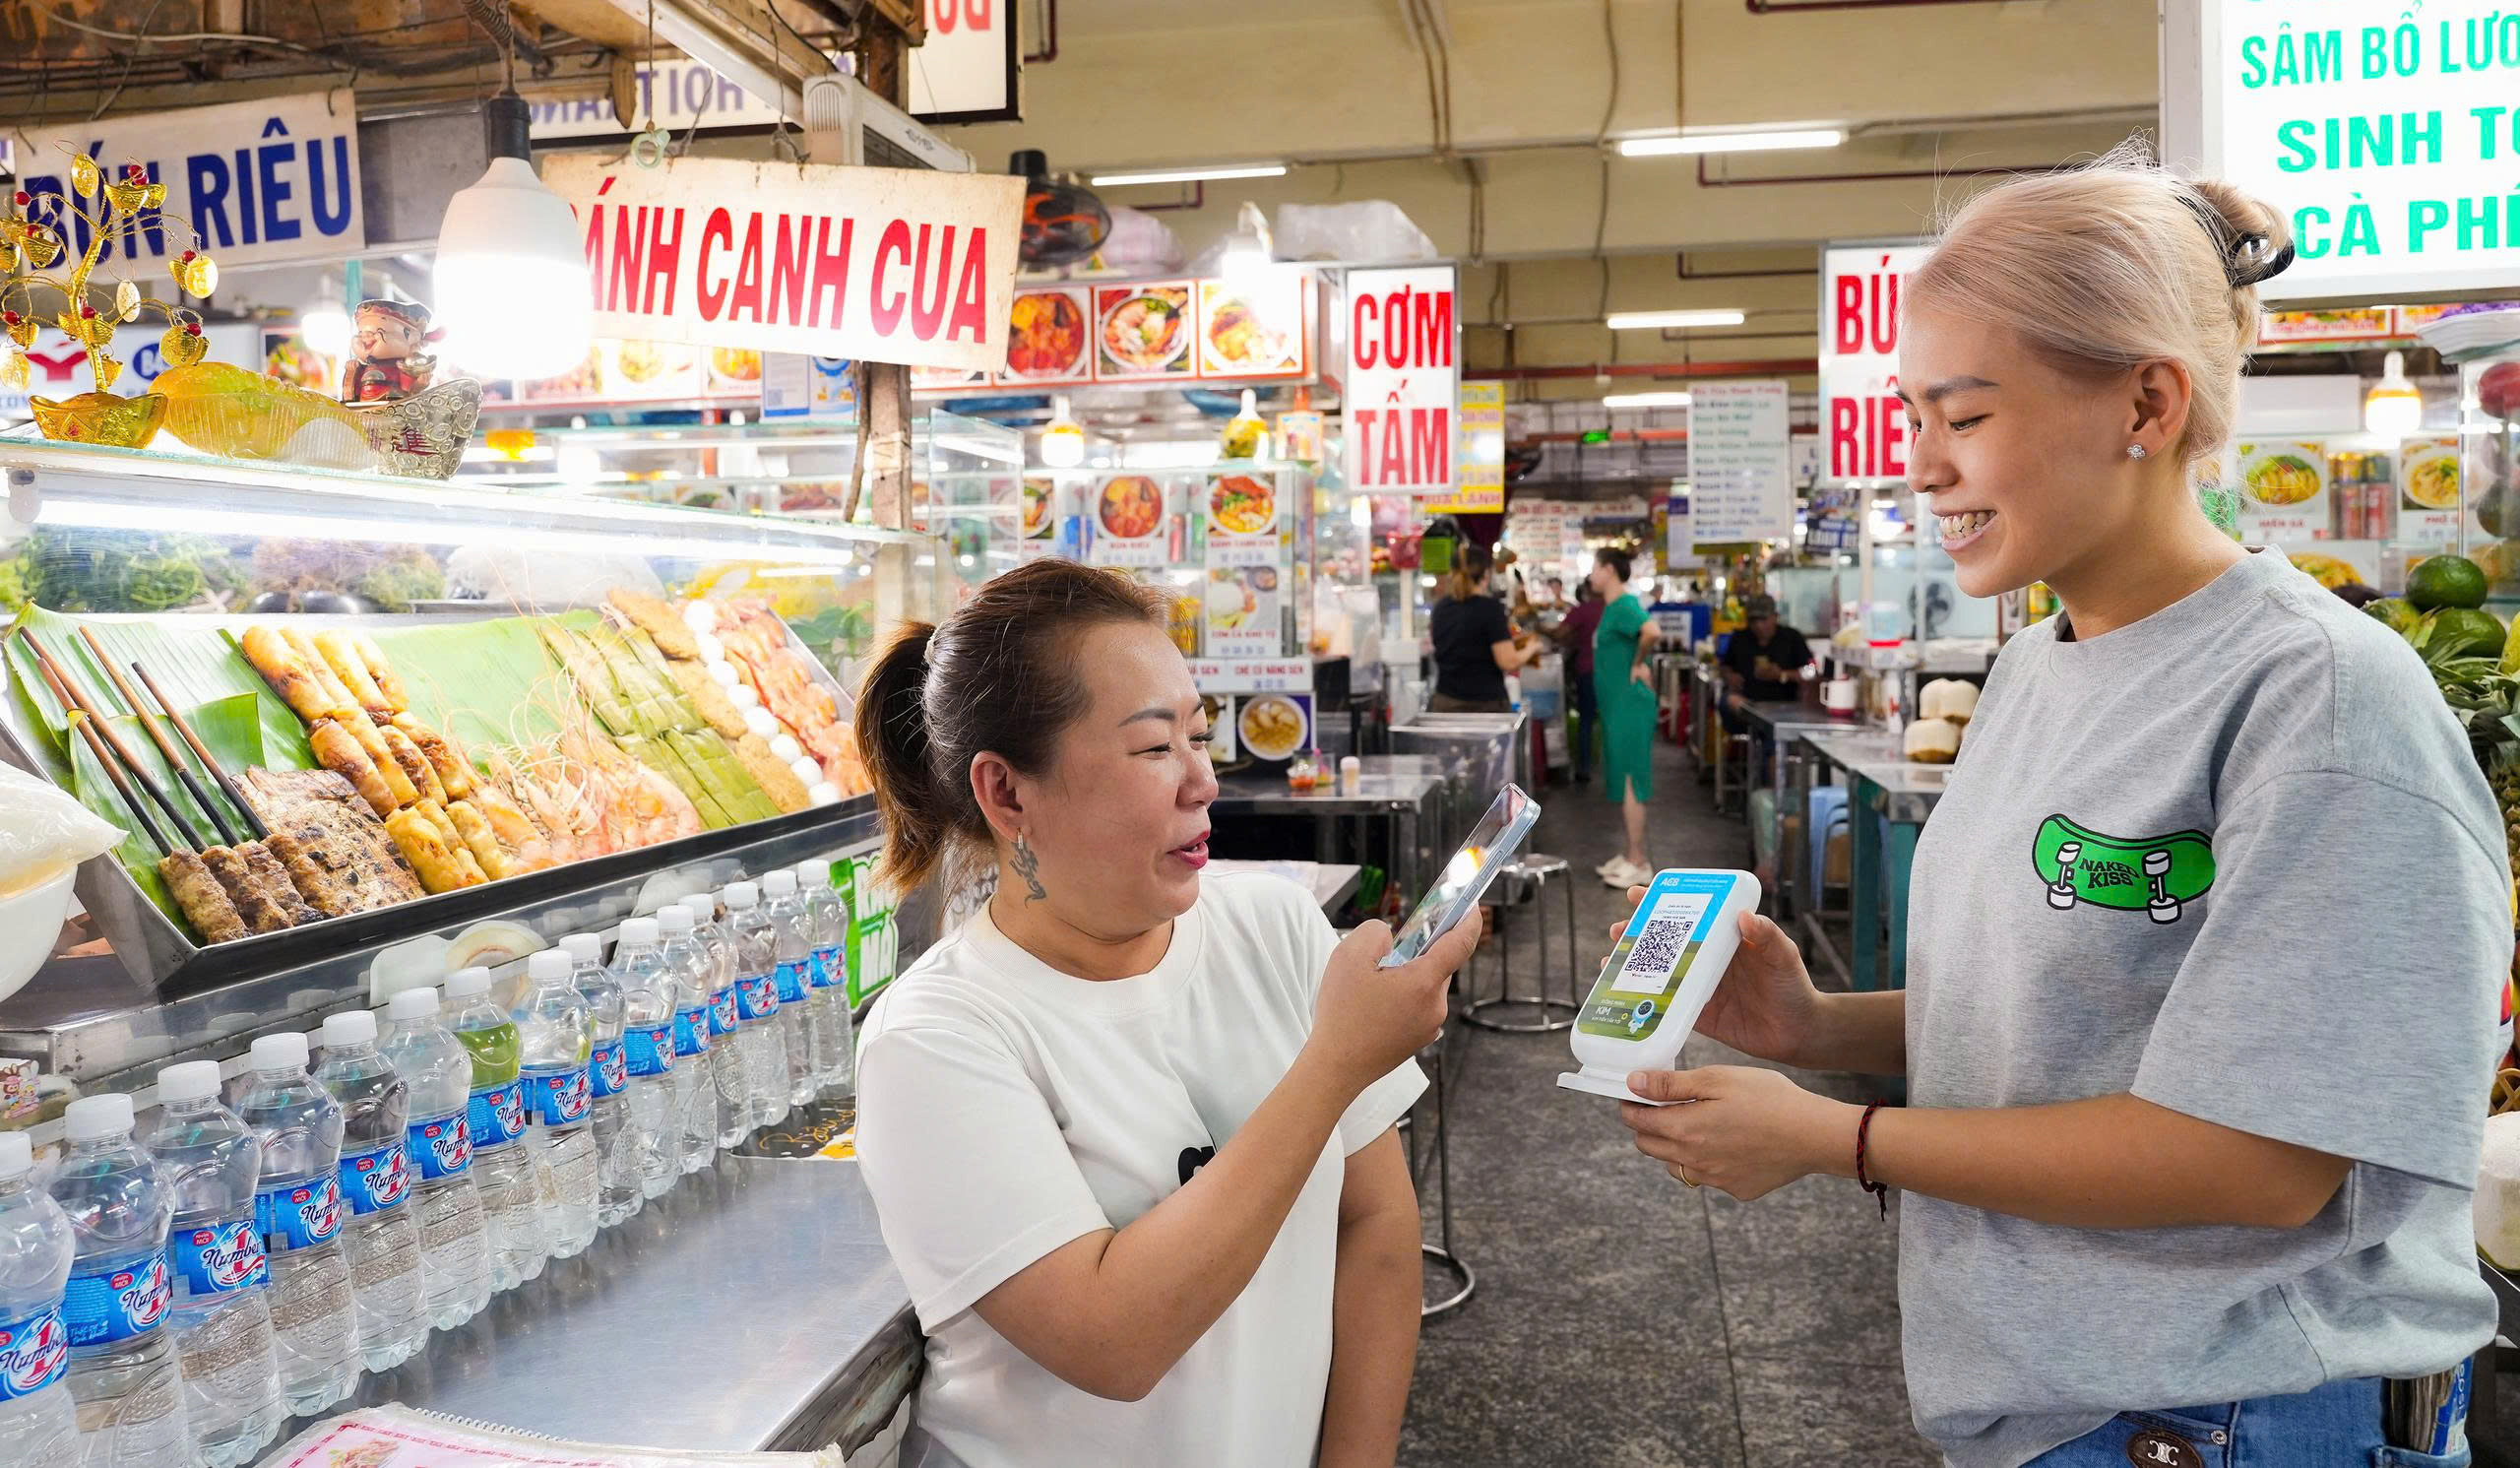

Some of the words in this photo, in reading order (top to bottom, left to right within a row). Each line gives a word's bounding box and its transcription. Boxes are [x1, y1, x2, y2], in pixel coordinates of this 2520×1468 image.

[2240, 22, 2342, 89] SÂM
[2362, 1, 2424, 80] BỔ
[2276, 110, 2443, 173] SINH
[24, 140, 165, 271] BÚN
[186, 115, 354, 251] RIÊU
[2293, 192, 2382, 260] CÀ
[570, 175, 685, 317] ÁNH
[696, 205, 854, 331] CANH
[868, 218, 986, 345] CUA
[1353, 284, 1454, 371] CƠM
[1835, 255, 1903, 355] BÚ
[1354, 378, 1449, 486] TẤM
[1831, 375, 1920, 478] RIÊ
[2078, 858, 2141, 880] NAKED
[2087, 871, 2134, 889] KISS
[455, 1122, 465, 1160] 1
[324, 1183, 336, 1228] 1
[389, 1154, 402, 1194] 1
[203, 1235, 261, 1270] Number
[233, 1229, 248, 1272] 1
[143, 1263, 163, 1318] 1
[32, 1322, 53, 1376] 1
